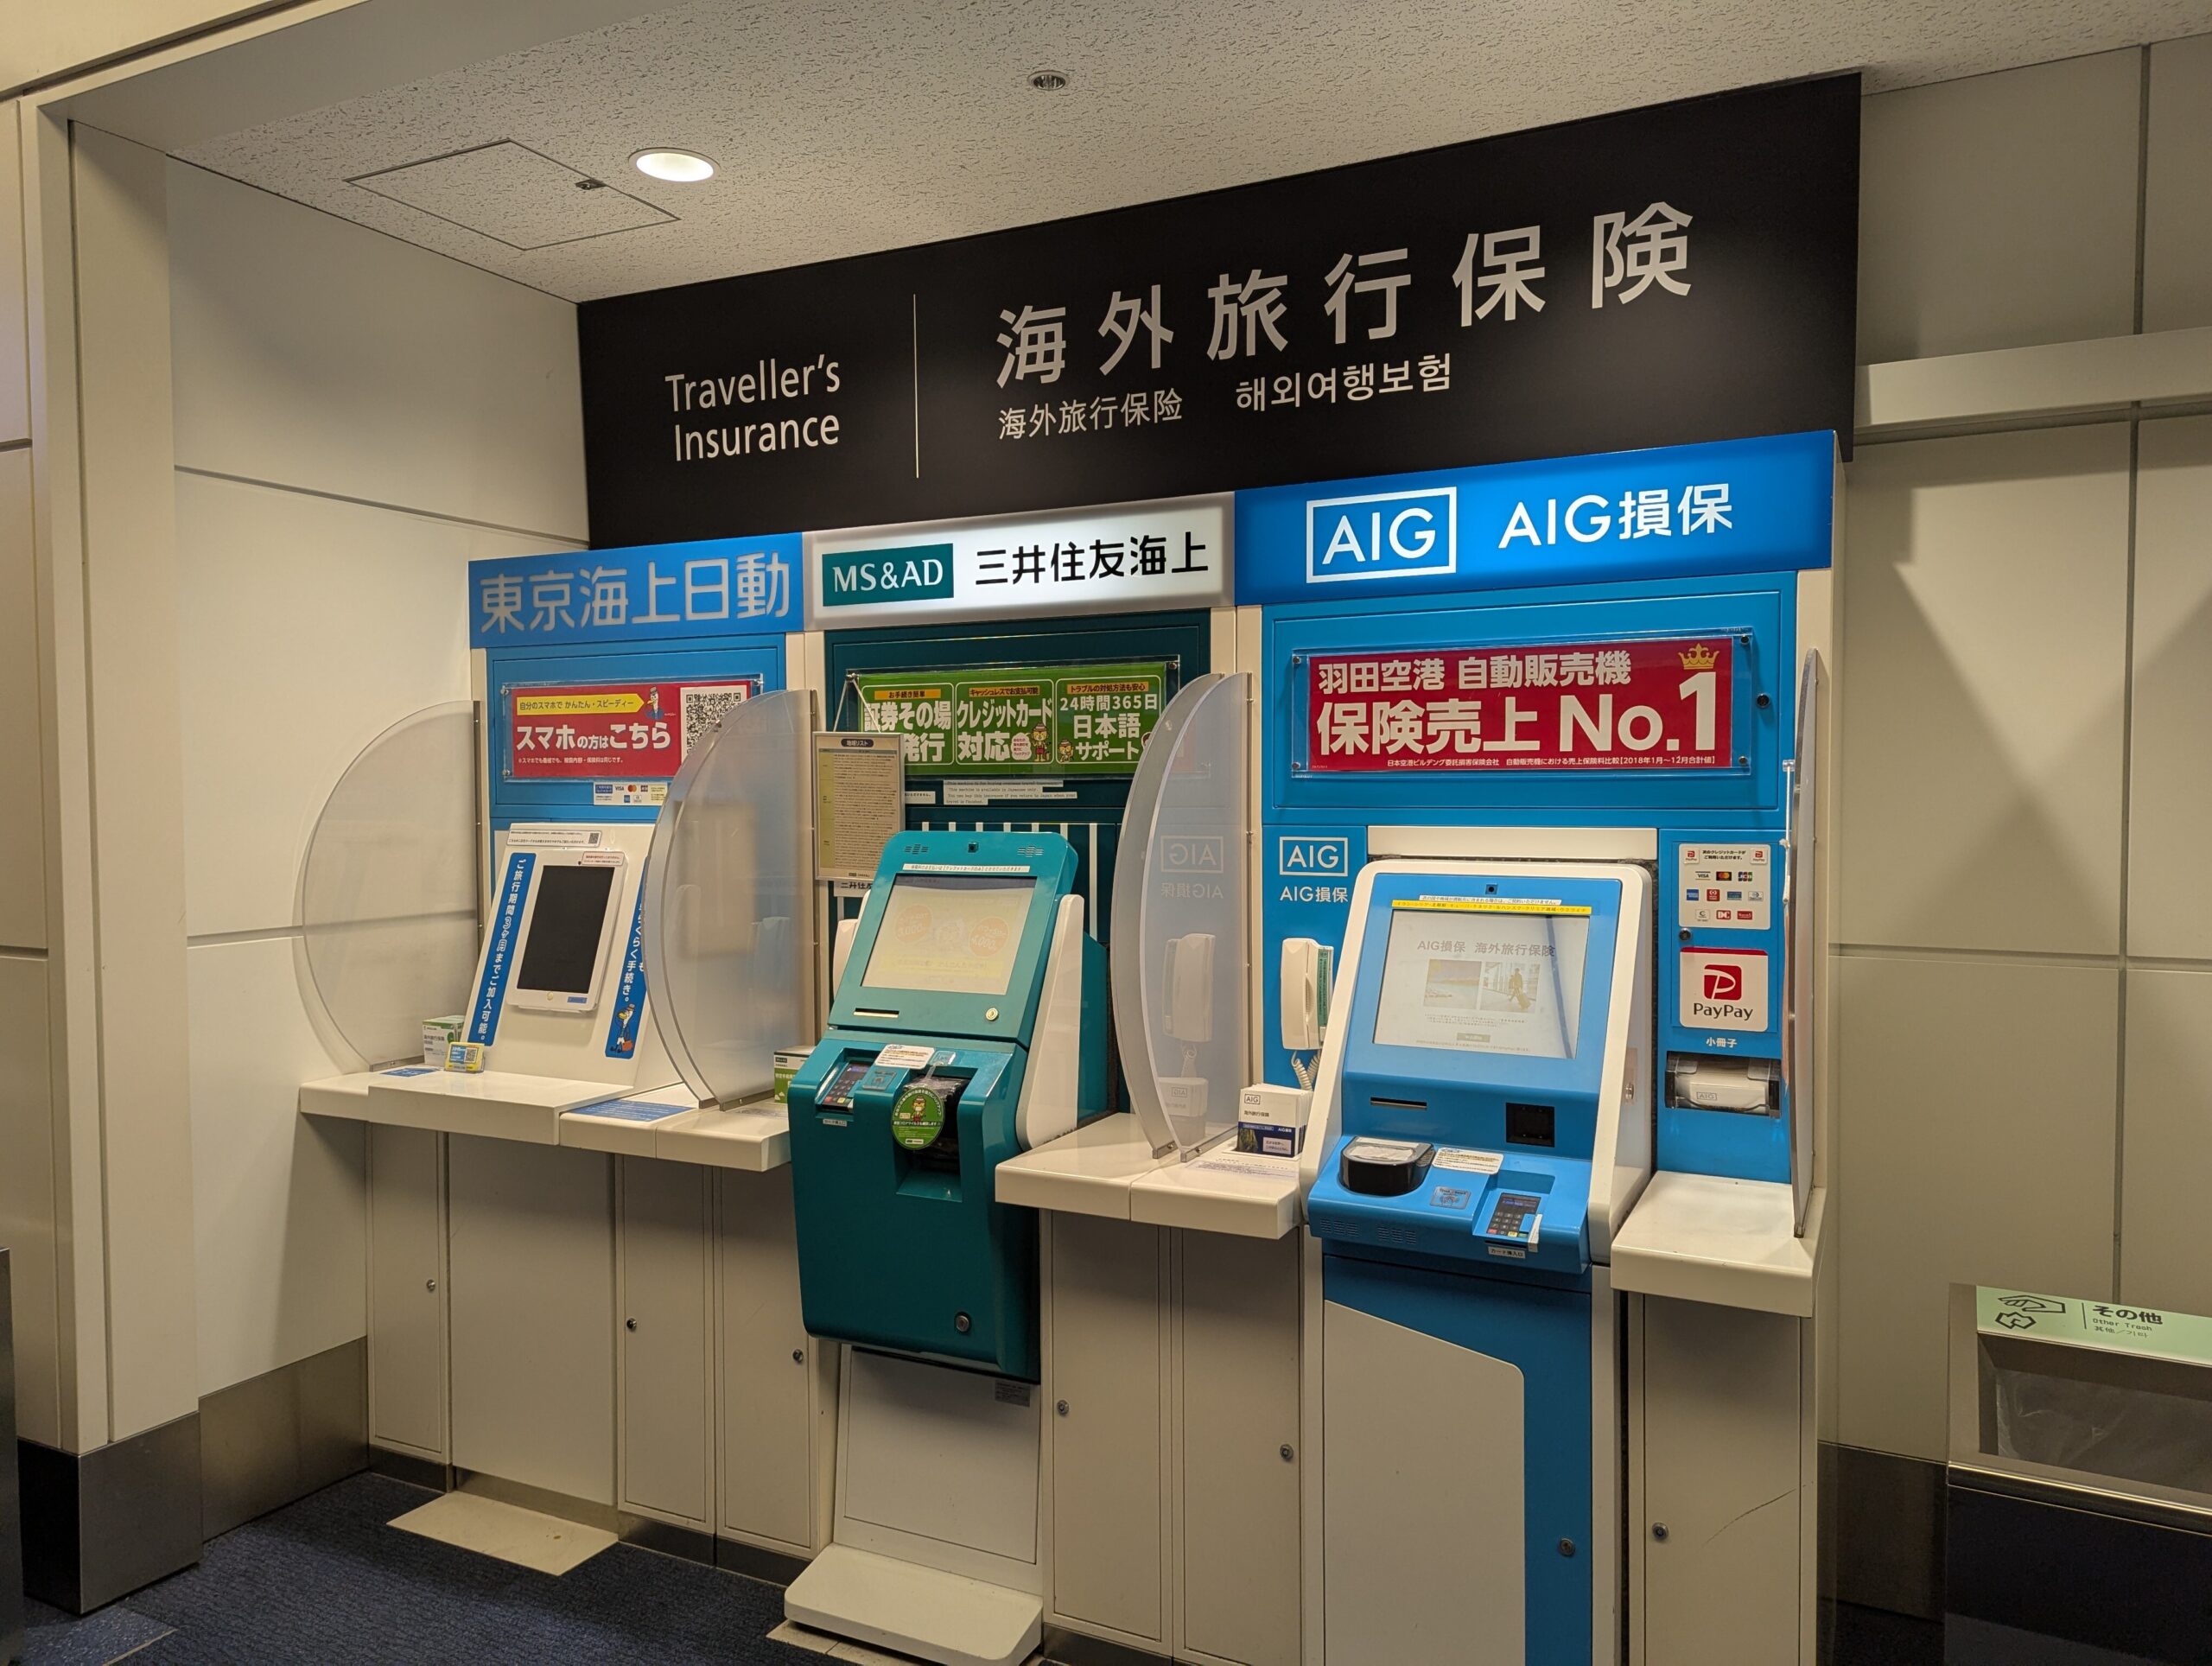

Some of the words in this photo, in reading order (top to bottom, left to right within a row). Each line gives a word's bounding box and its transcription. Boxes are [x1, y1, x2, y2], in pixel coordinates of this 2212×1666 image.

[996, 201, 1693, 389] 海外旅行保険
[664, 353, 841, 412] Traveller's
[1235, 353, 1452, 411] 해외여행보험
[998, 387, 1184, 441] 海外旅行保险
[674, 414, 840, 461] Insurance
[1497, 482, 1732, 549] AIG損保
[1322, 506, 1437, 564] AIG
[975, 531, 1209, 586] 三井住友海上
[832, 558, 944, 593] MS&AD
[480, 551, 791, 634] 東京海上日動
[1071, 683, 1146, 693] トラブルの対処方法も安心
[1318, 658, 1446, 696] 羽田空港
[1459, 651, 1632, 689] 自動販売機
[519, 701, 563, 710] 自分のスマホで
[864, 700, 952, 732] 証券その場
[957, 697, 1053, 729] クレジットカード
[1059, 694, 1158, 712] 24時間365日
[1316, 696, 1541, 756] 保険売上
[1559, 671, 1717, 752] No.1
[516, 722, 671, 751] スマホの方はこちら
[1073, 713, 1141, 740] 日本語
[957, 730, 1011, 761] 対応
[1075, 740, 1140, 760] サポート
[1287, 844, 1339, 868] AIG
[1280, 886, 1349, 903] AIG損保
[1417, 940, 1466, 953] AIG損保
[1474, 941, 1556, 957] 海外旅行保険
[1693, 1002, 1754, 1021] PayPay
[1705, 1037, 1738, 1048] 小冊子
[2092, 1305, 2164, 1325] その他
[2124, 1322, 2153, 1332] Trash
